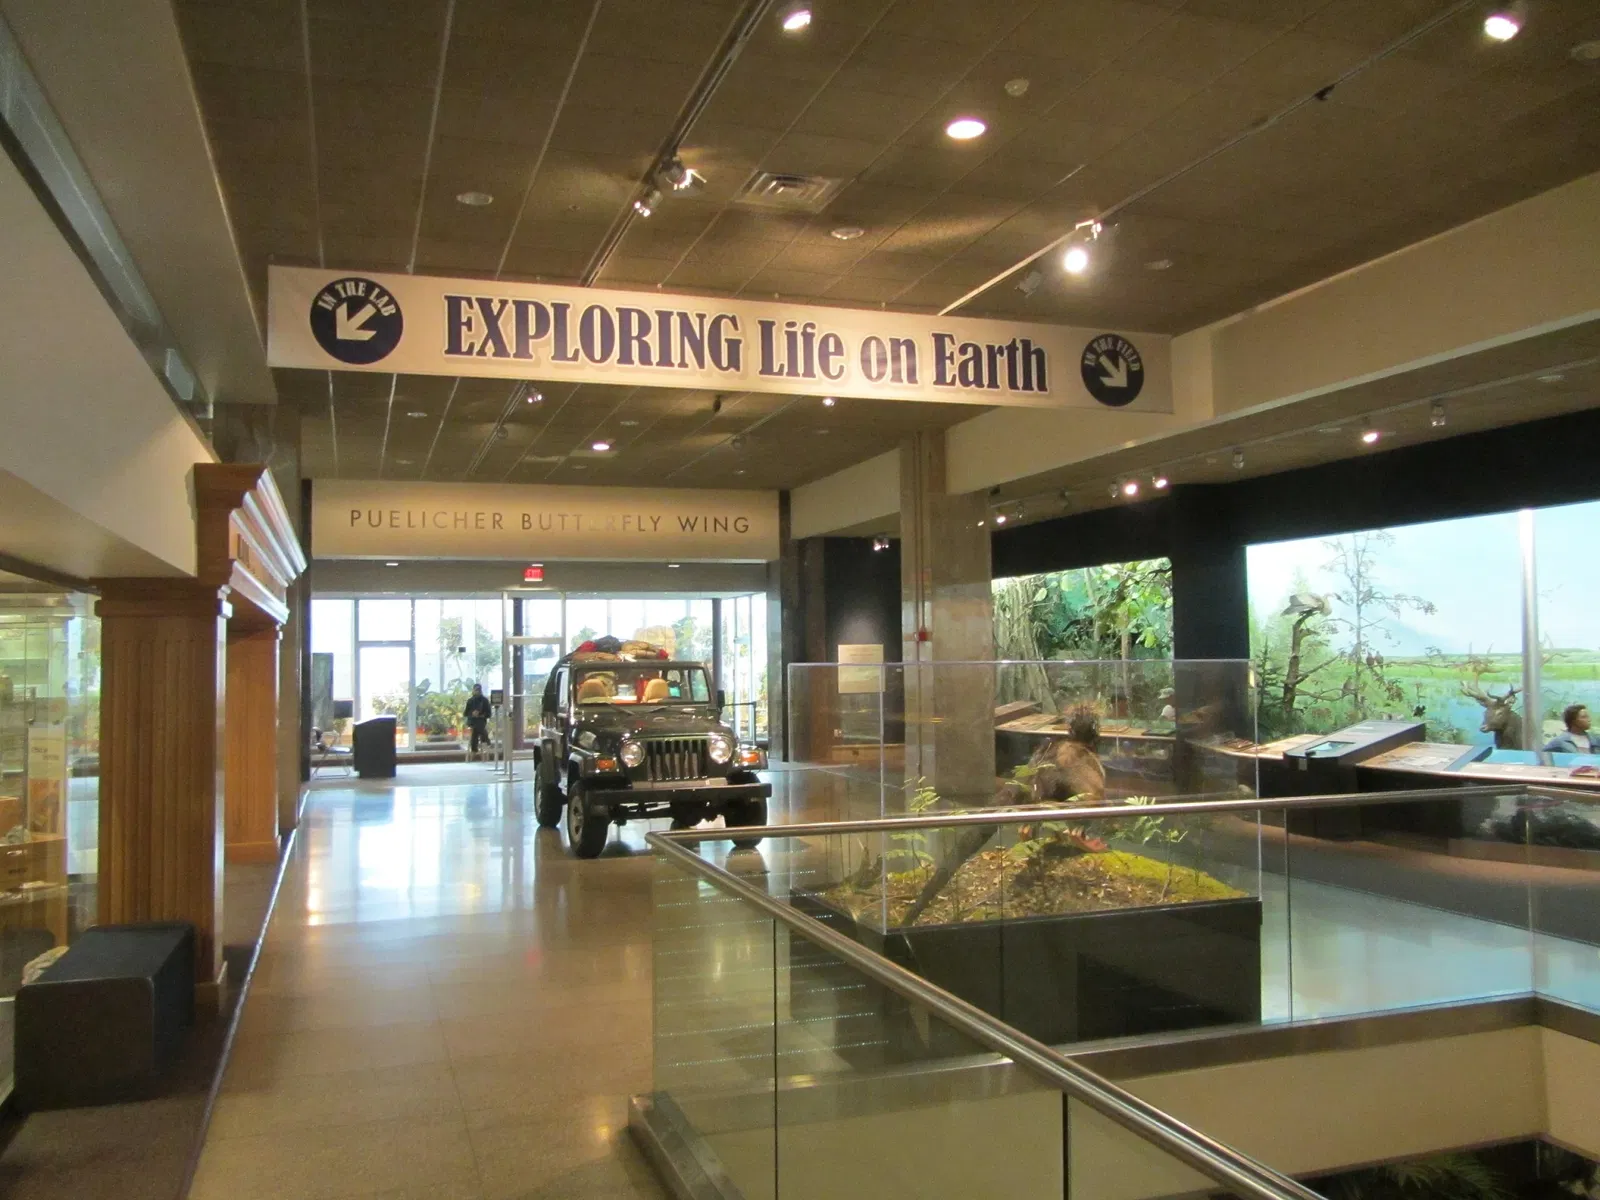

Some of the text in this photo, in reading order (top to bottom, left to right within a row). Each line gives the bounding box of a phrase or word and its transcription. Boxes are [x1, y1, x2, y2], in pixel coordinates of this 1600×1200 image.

[317, 281, 396, 316] IN THE LAB
[443, 294, 1049, 393] EXPLORING Life on Earth
[1092, 336, 1114, 354] THE
[349, 509, 505, 530] PUELICHER
[677, 515, 750, 534] WING
